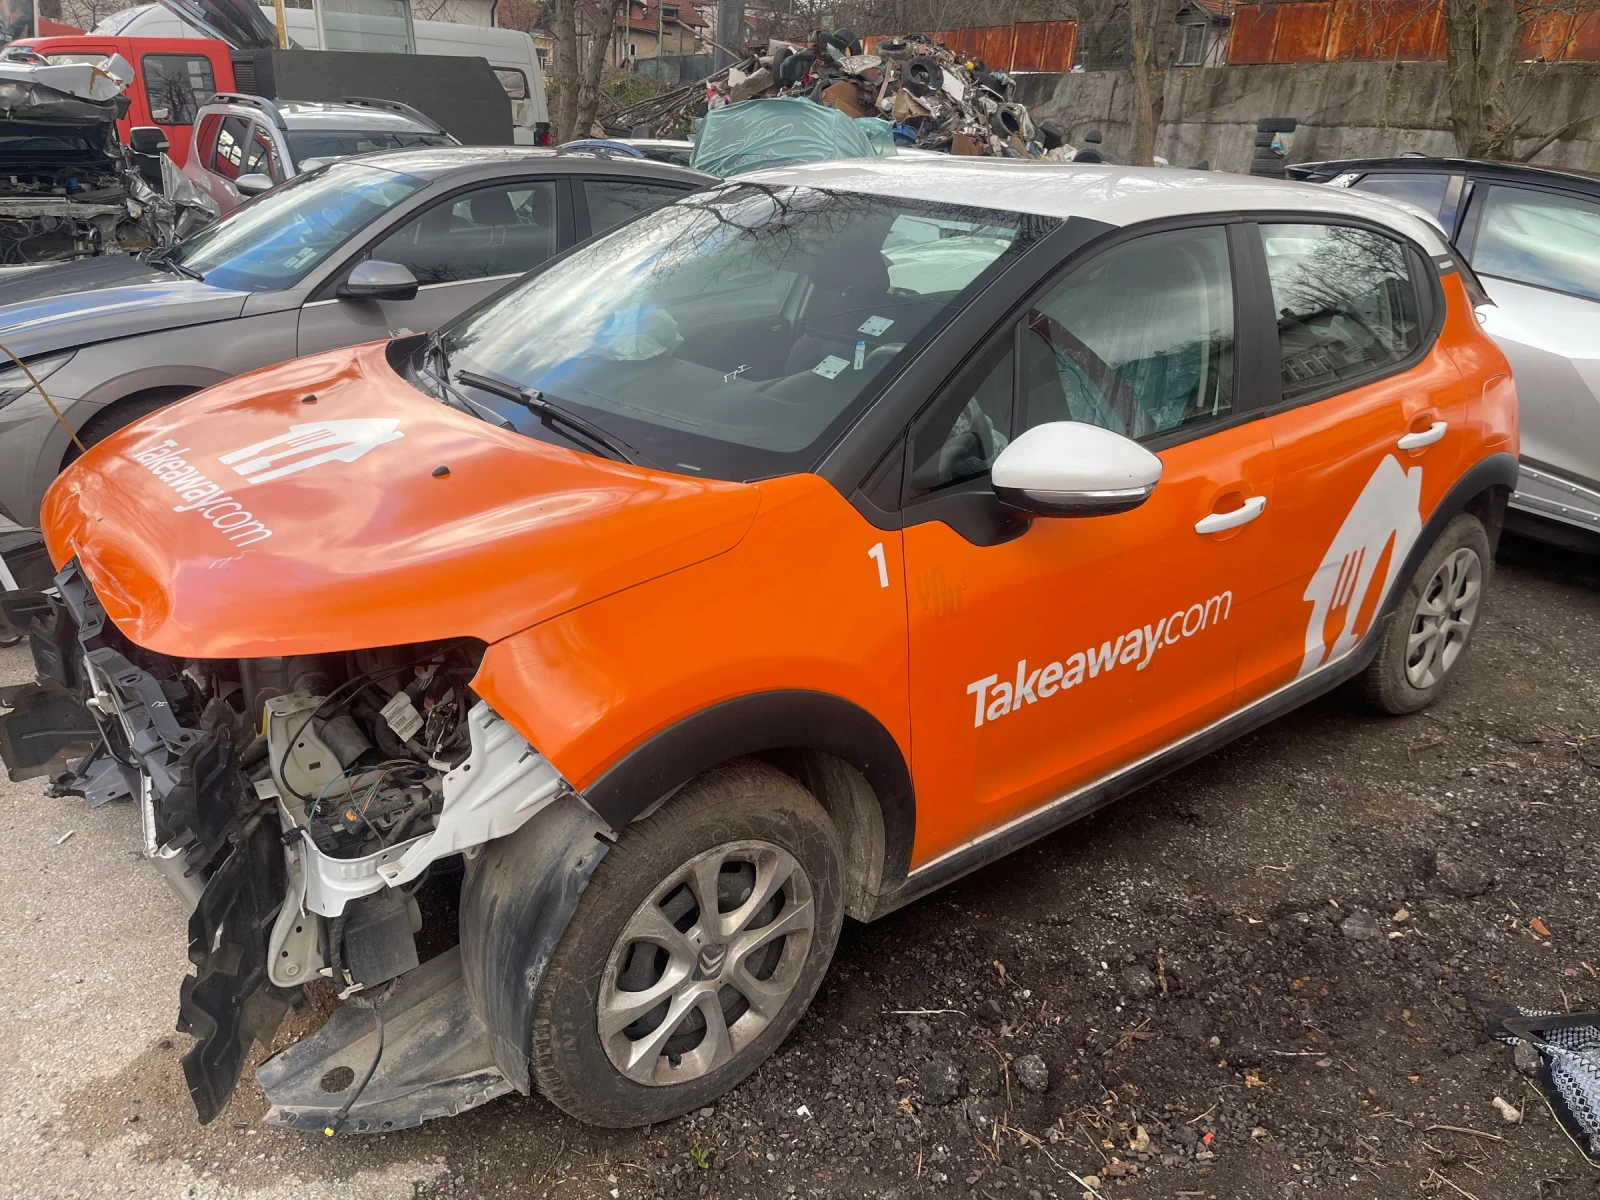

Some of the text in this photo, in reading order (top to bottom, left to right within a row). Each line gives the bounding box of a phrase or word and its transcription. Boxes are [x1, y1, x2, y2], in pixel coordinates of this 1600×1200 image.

[132, 439, 273, 548] Takeaway.com
[867, 542, 890, 588] 1
[966, 590, 1233, 728] Takeaway.com
